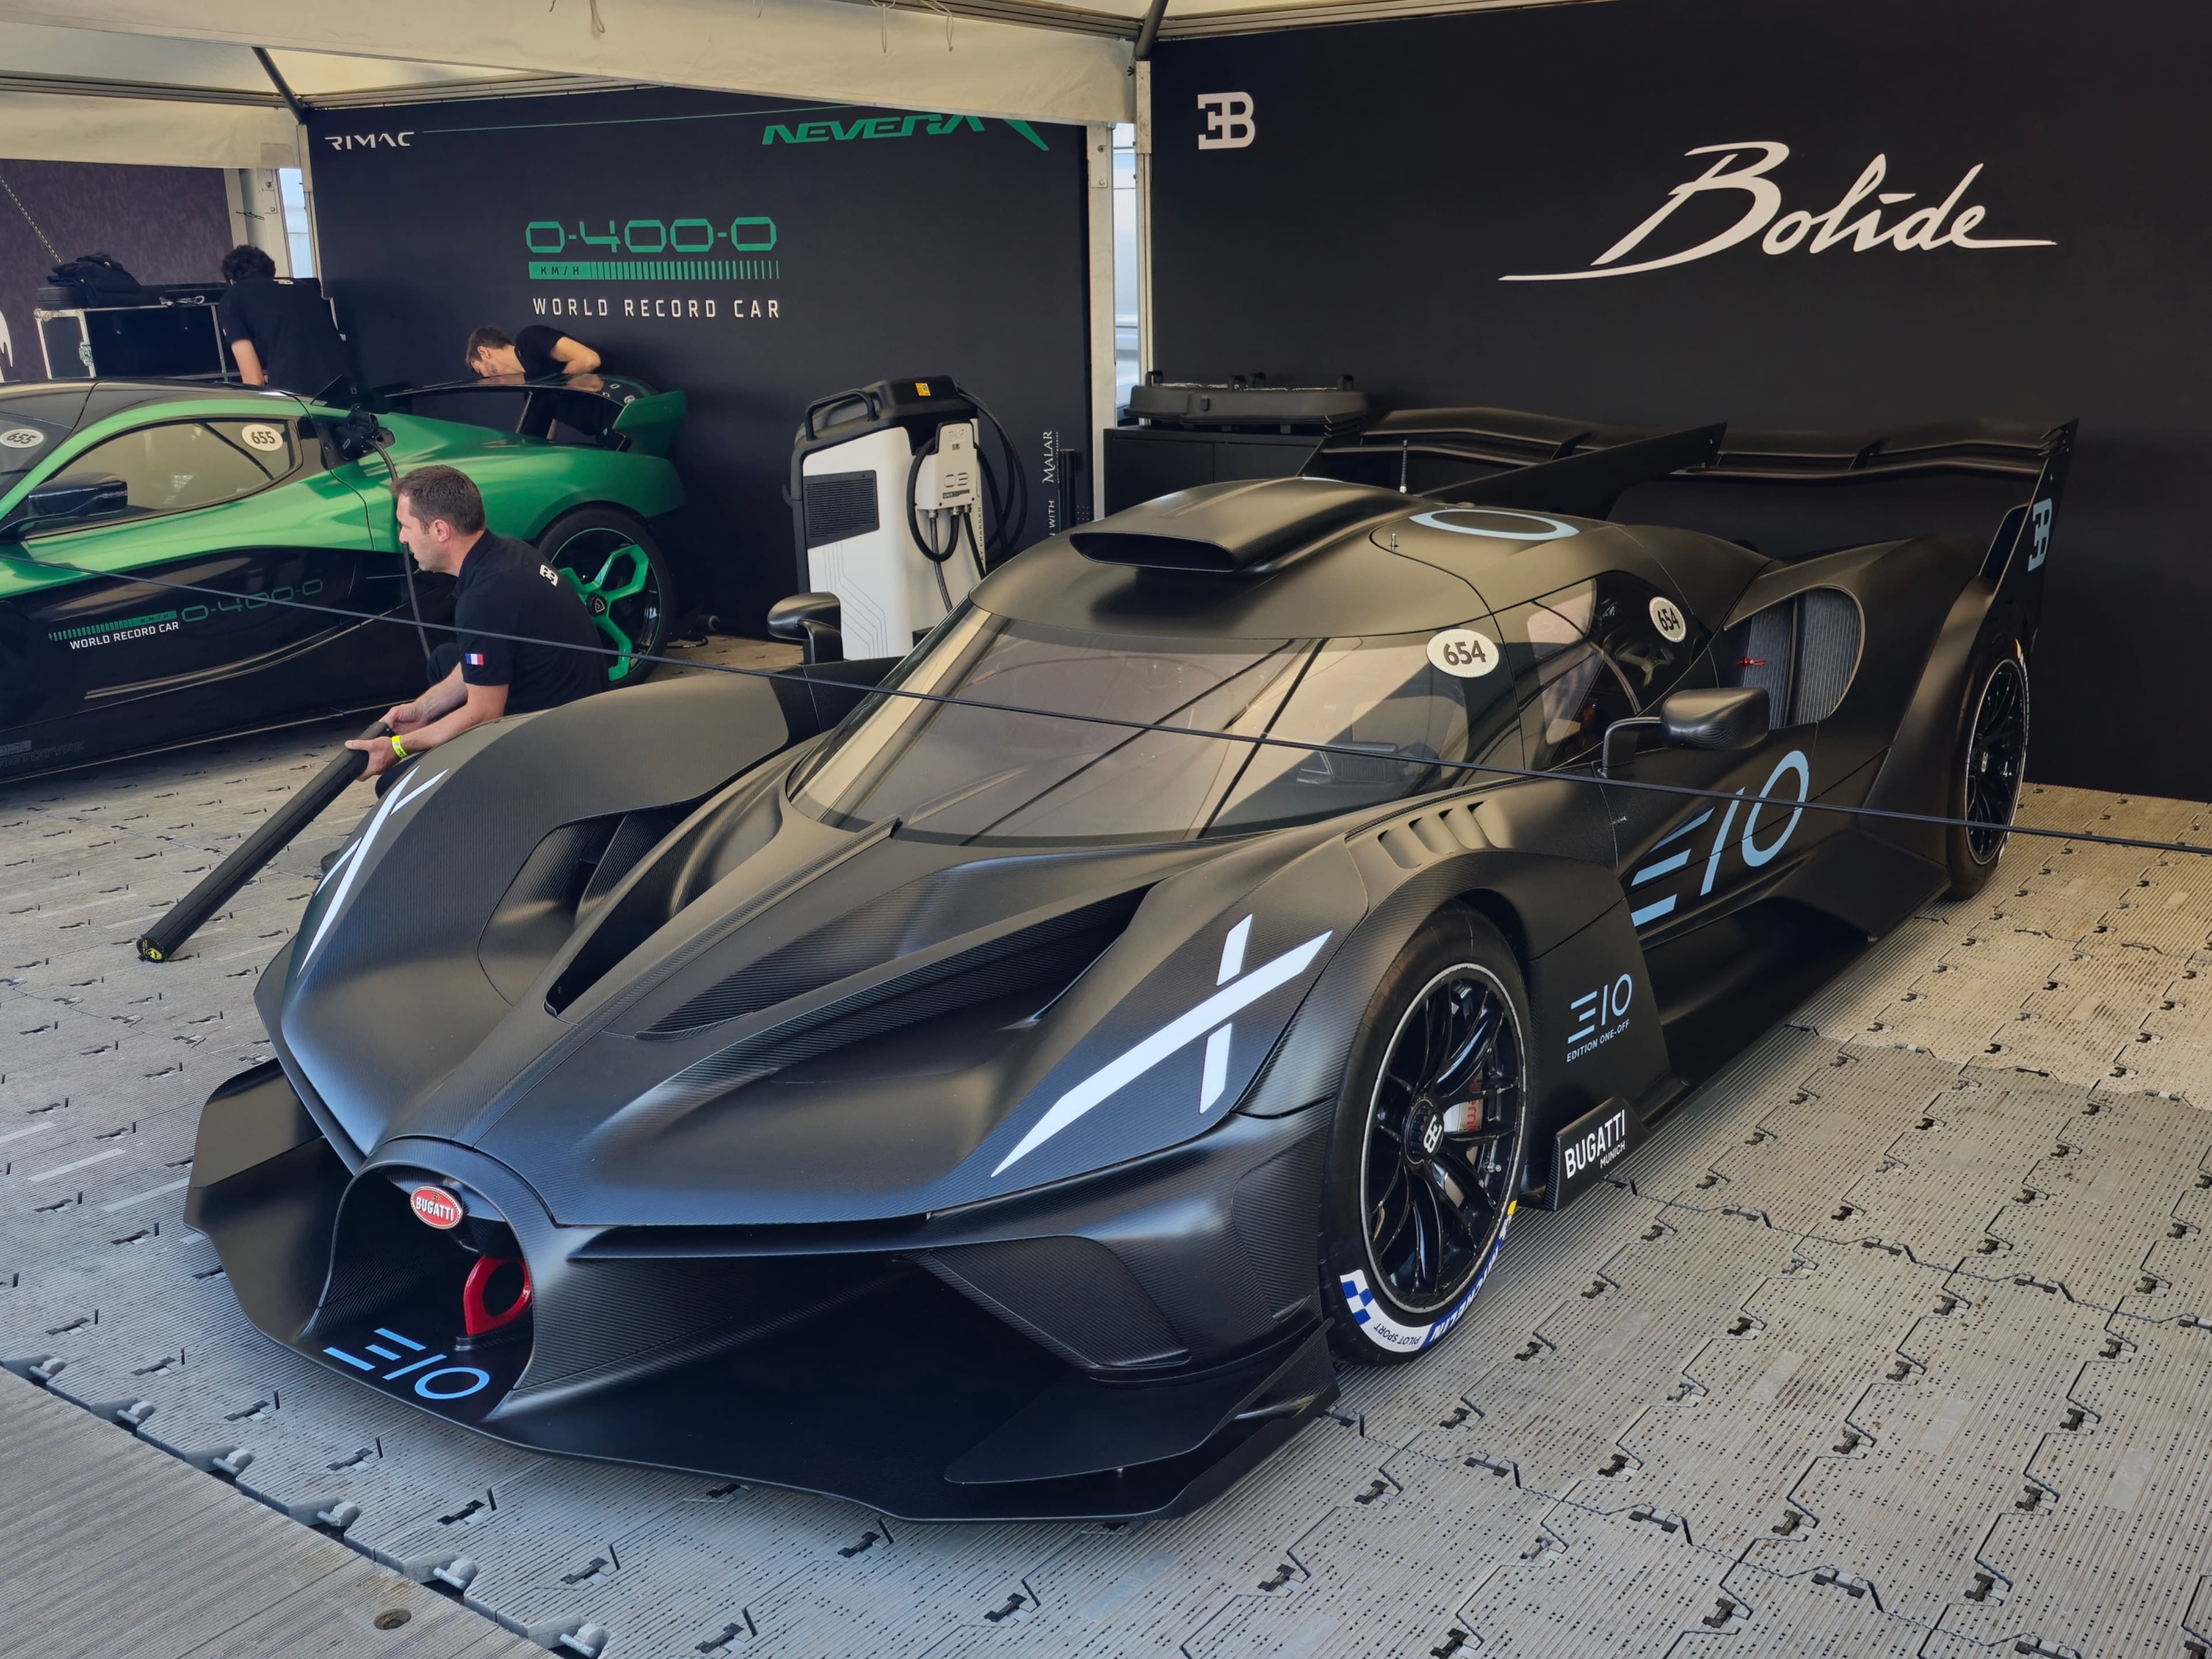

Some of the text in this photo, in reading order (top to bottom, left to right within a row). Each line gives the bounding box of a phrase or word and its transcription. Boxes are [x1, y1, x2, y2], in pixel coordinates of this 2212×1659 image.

[325, 131, 415, 150] RIMAC
[1498, 141, 2058, 281] Bolide
[533, 298, 779, 318] WORLD RECORD CAR
[6, 430, 34, 445] 655
[251, 430, 276, 445] 655
[1041, 430, 1056, 484] MALAR
[1658, 608, 1680, 631] 654
[70, 621, 180, 650] WORLD RECORD CAR
[1444, 640, 1486, 665] 654
[1566, 1018, 1630, 1063] EDITION ONE-OFF
[1564, 1109, 1626, 1180] BUGATTI
[1600, 1140, 1626, 1169] MUNICH
[416, 1196, 455, 1222] BUGATTI
[1373, 1323, 1422, 1345] PILOT SPORT
